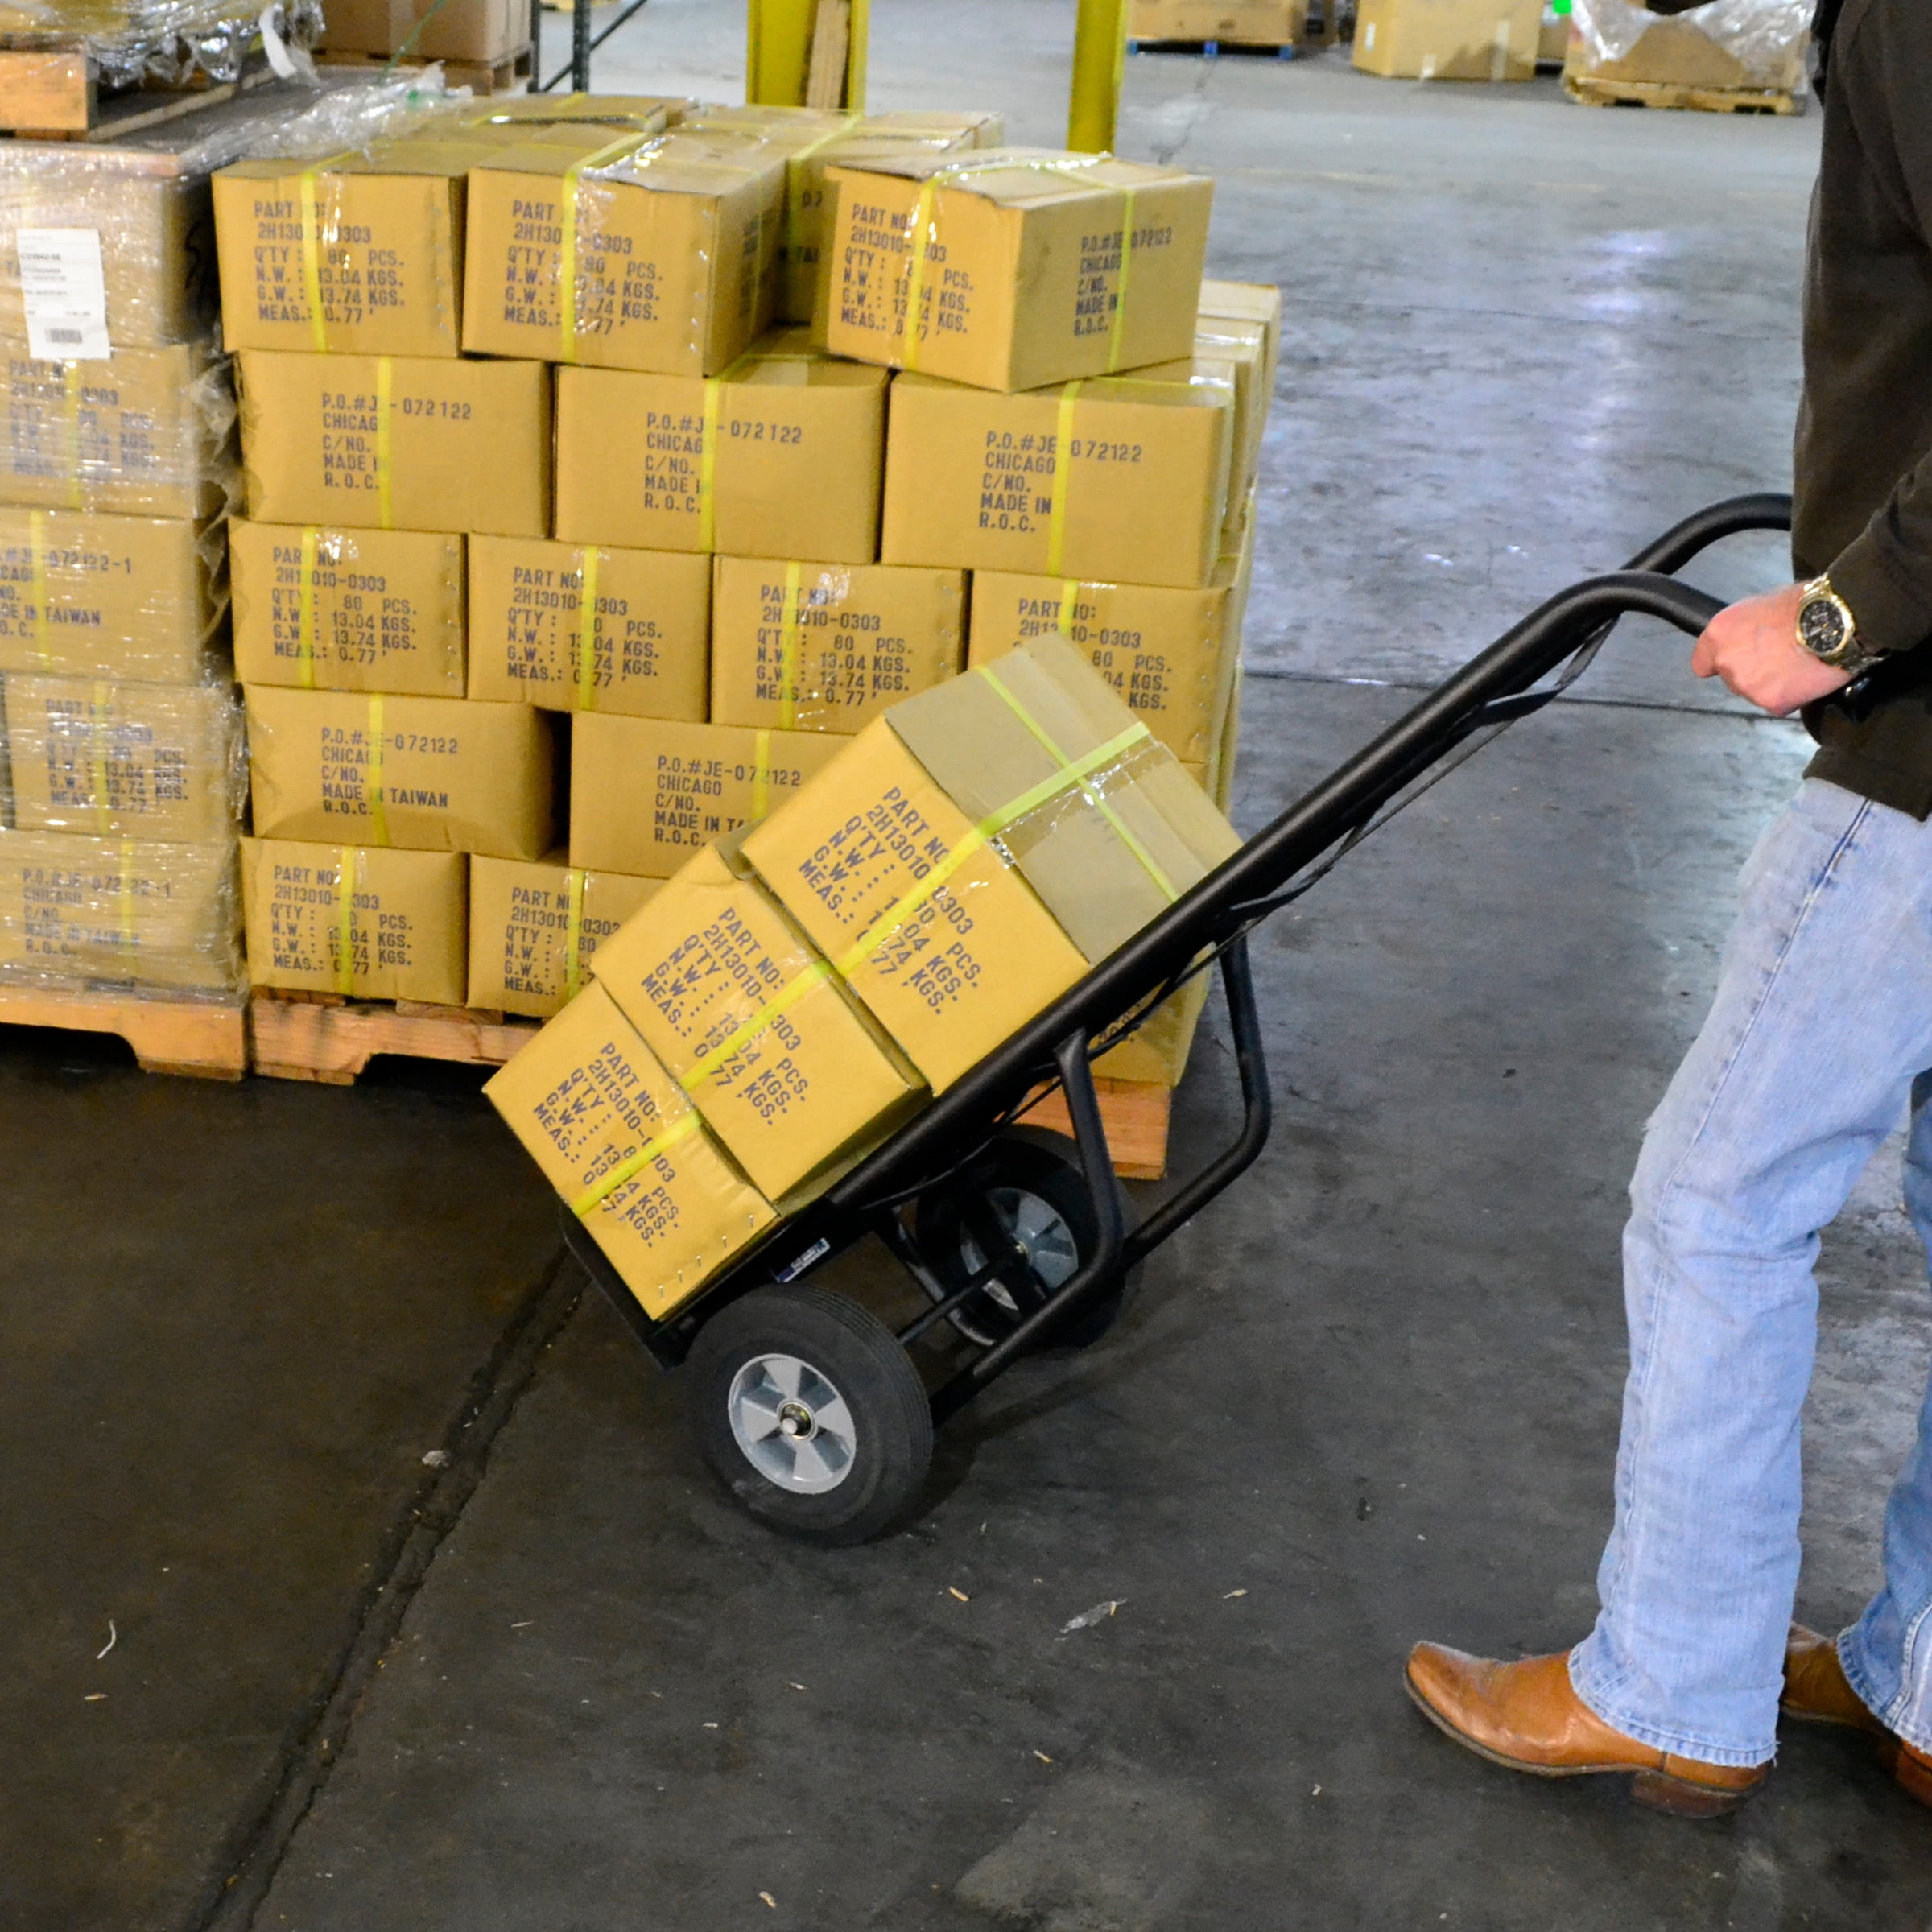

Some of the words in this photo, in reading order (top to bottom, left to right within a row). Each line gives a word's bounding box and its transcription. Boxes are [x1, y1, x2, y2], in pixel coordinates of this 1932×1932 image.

[254, 201, 293, 217] PART
[513, 200, 555, 221] PART
[852, 204, 886, 225] PART
[369, 249, 404, 266] PCS.
[367, 270, 403, 287] KGS.
[627, 261, 663, 281] PCS.
[943, 268, 973, 291] PCS.
[369, 288, 404, 306] KGS.
[623, 280, 659, 301] KGS.
[621, 301, 658, 320] KGS.
[939, 291, 970, 312] KGS.
[938, 312, 968, 333] KGS.
[323, 413, 378, 432] CHICAG
[323, 435, 370, 452] C/NO.
[646, 432, 703, 454] CHICAG
[324, 453, 365, 471] MADE
[645, 455, 695, 475] C/NO.
[985, 452, 1056, 474] CHICAGO
[324, 472, 380, 490] R.O.C.
[644, 474, 688, 493] MADE
[983, 473, 1031, 493] C/NO.
[644, 493, 702, 514] R.O.C.
[980, 493, 1028, 512] MADE
[1035, 497, 1052, 514] IN
[979, 512, 1036, 533] R.O.C.
[273, 547, 301, 564] PAR
[514, 566, 553, 587] PART
[344, 595, 362, 610] 80
[382, 598, 417, 615] PCS.
[1018, 598, 1061, 618] PART
[44, 607, 100, 625] TAIWAN
[332, 611, 374, 630] 13.04
[381, 616, 416, 634] KGS.
[626, 620, 663, 638] PCS.
[334, 630, 375, 646] 13.74
[382, 634, 416, 650] KGS.
[623, 640, 659, 658] KGS.
[876, 637, 913, 654] PCS.
[622, 659, 658, 677] KGS.
[820, 653, 866, 671] 13.04
[873, 655, 910, 674] KGS.
[1135, 654, 1172, 672] PCS.
[820, 671, 865, 688] 13.74
[872, 675, 910, 691] KGS.
[1130, 672, 1169, 692] KGS.
[1129, 693, 1166, 710] KGS.
[322, 765, 365, 782] C/NO.
[322, 783, 362, 800] MADE
[390, 788, 448, 808] TAIWAN
[658, 774, 722, 796] CHICAGO
[655, 793, 700, 812] C/NO.
[883, 786, 929, 837] PART
[654, 811, 698, 829] MADE
[705, 816, 720, 832] IN
[654, 828, 706, 847] R.O.C.
[274, 865, 311, 883] PART
[512, 886, 551, 908] PART
[798, 858, 855, 924] MEAS.:
[378, 914, 413, 931] PCS.
[829, 829, 865, 876] N.W.
[926, 955, 961, 1002] KGS.
[378, 932, 412, 949] KGS.
[814, 845, 849, 891] G.W.
[910, 969, 945, 1015] KGS.
[378, 949, 411, 965] KGS.
[718, 906, 761, 956] PART
[755, 956, 785, 991] NO:
[946, 941, 982, 989] PCS.
[703, 924, 801, 1051] 2H13010-303
[640, 973, 692, 1038] MEAS.:
[669, 947, 701, 992] N.W.
[758, 1069, 791, 1114] KGS.
[655, 962, 687, 1006] G.W.
[744, 1082, 776, 1125] KGS.
[601, 1042, 640, 1088] PART
[634, 1090, 661, 1122] NO:
[776, 1057, 808, 1102] PCS.
[533, 1102, 580, 1163] MEAS.:
[558, 1080, 587, 1124] N.W.
[637, 1195, 667, 1237] KGS.
[545, 1092, 575, 1135] G.W.
[625, 1207, 654, 1248] KGS.
[651, 1187, 679, 1228] PCS.
